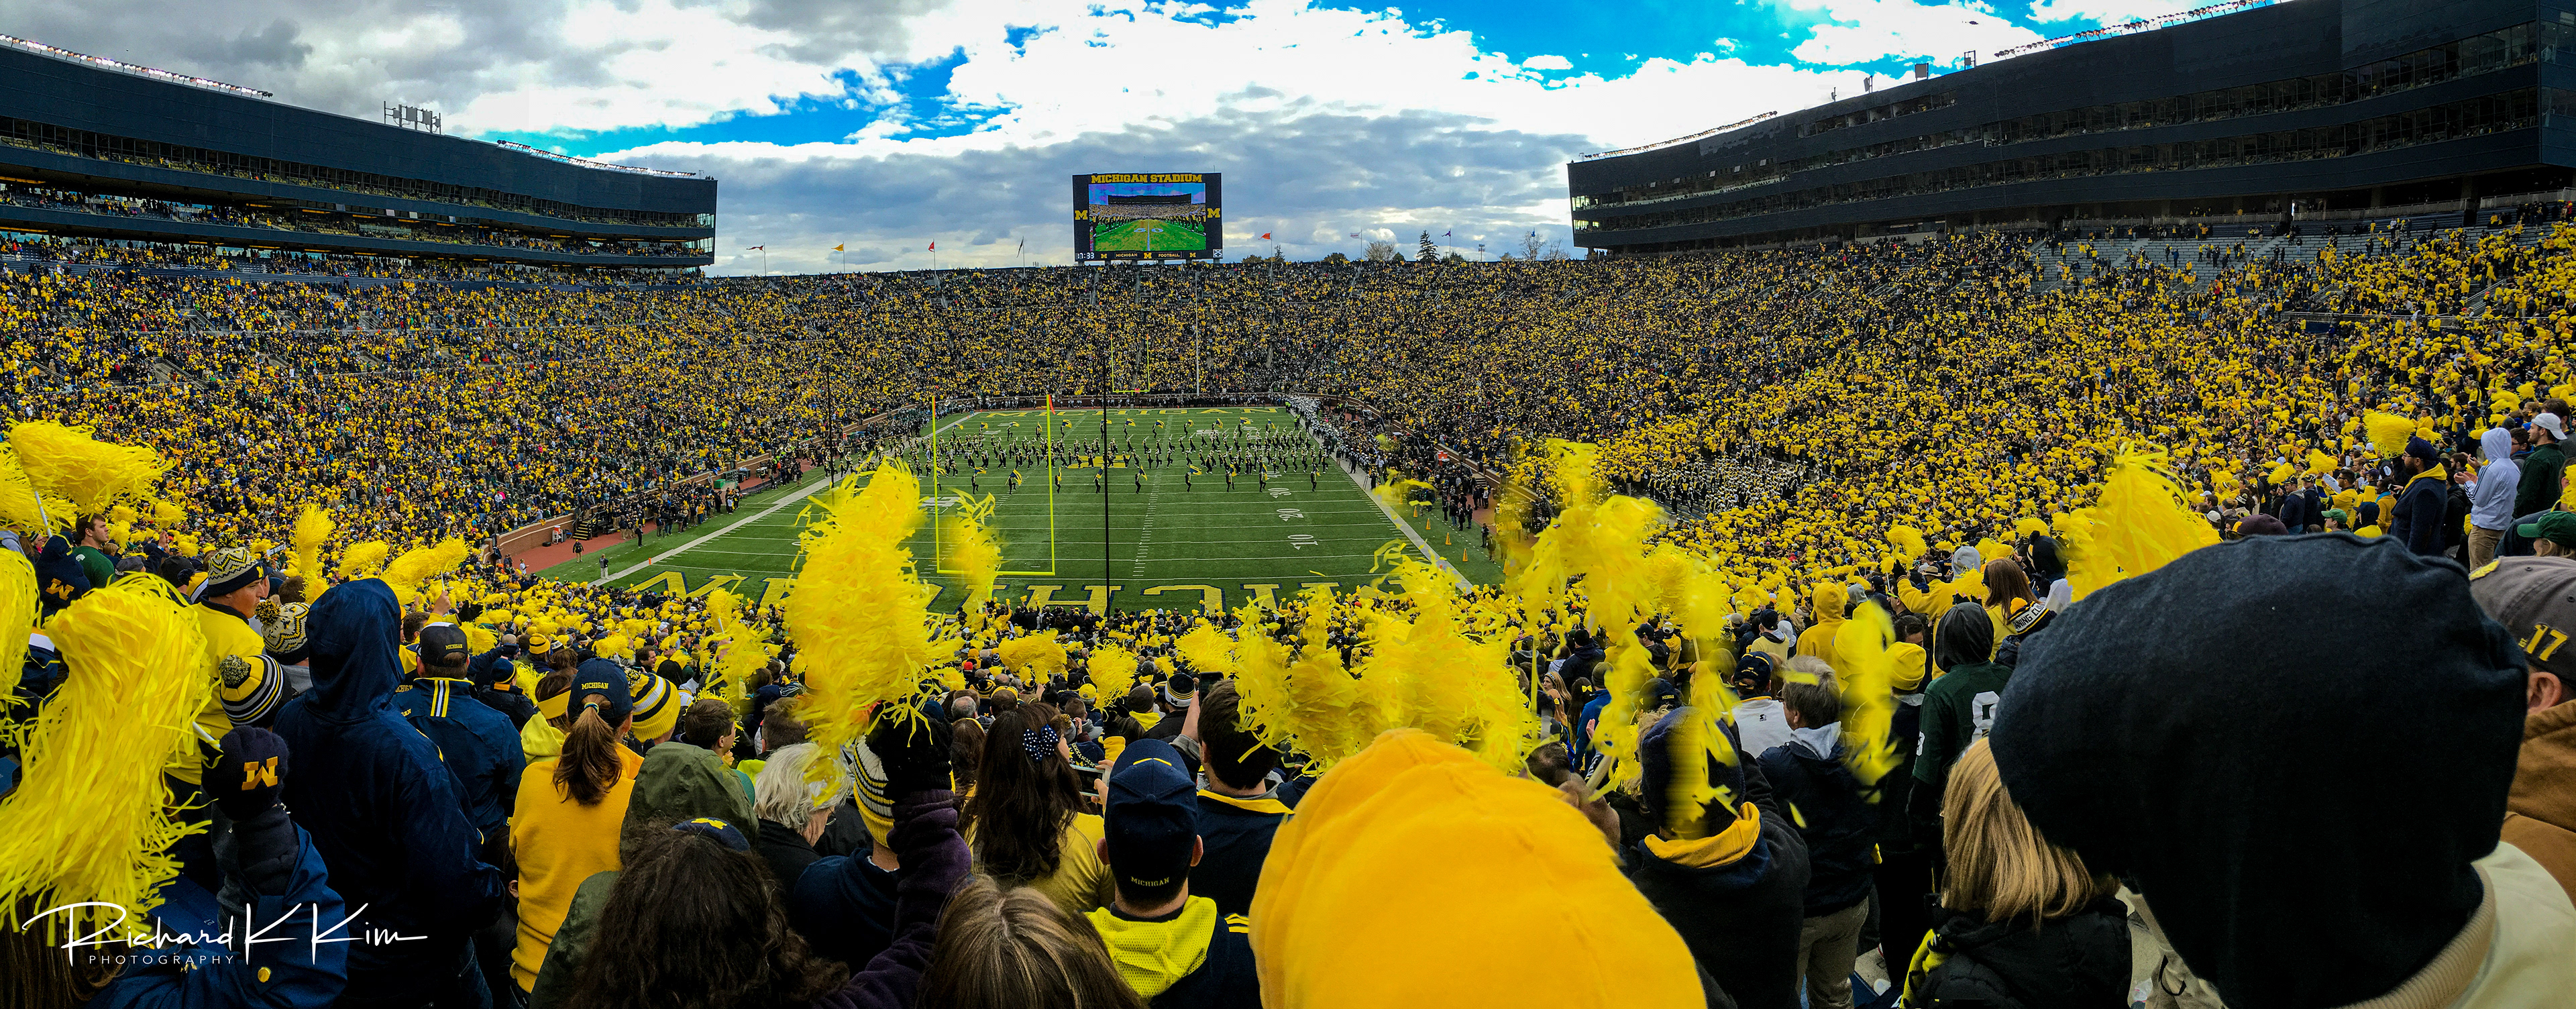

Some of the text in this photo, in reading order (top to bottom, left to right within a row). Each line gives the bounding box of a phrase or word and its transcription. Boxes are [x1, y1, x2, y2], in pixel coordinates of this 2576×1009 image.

[1091, 174, 1202, 183] MICHIGAN STADIUM
[1075, 210, 1087, 220] M
[1208, 208, 1220, 218] M
[2526, 624, 2569, 661] 17
[581, 682, 609, 690] MICHIGAN
[1130, 875, 1169, 887] MICHIGAN
